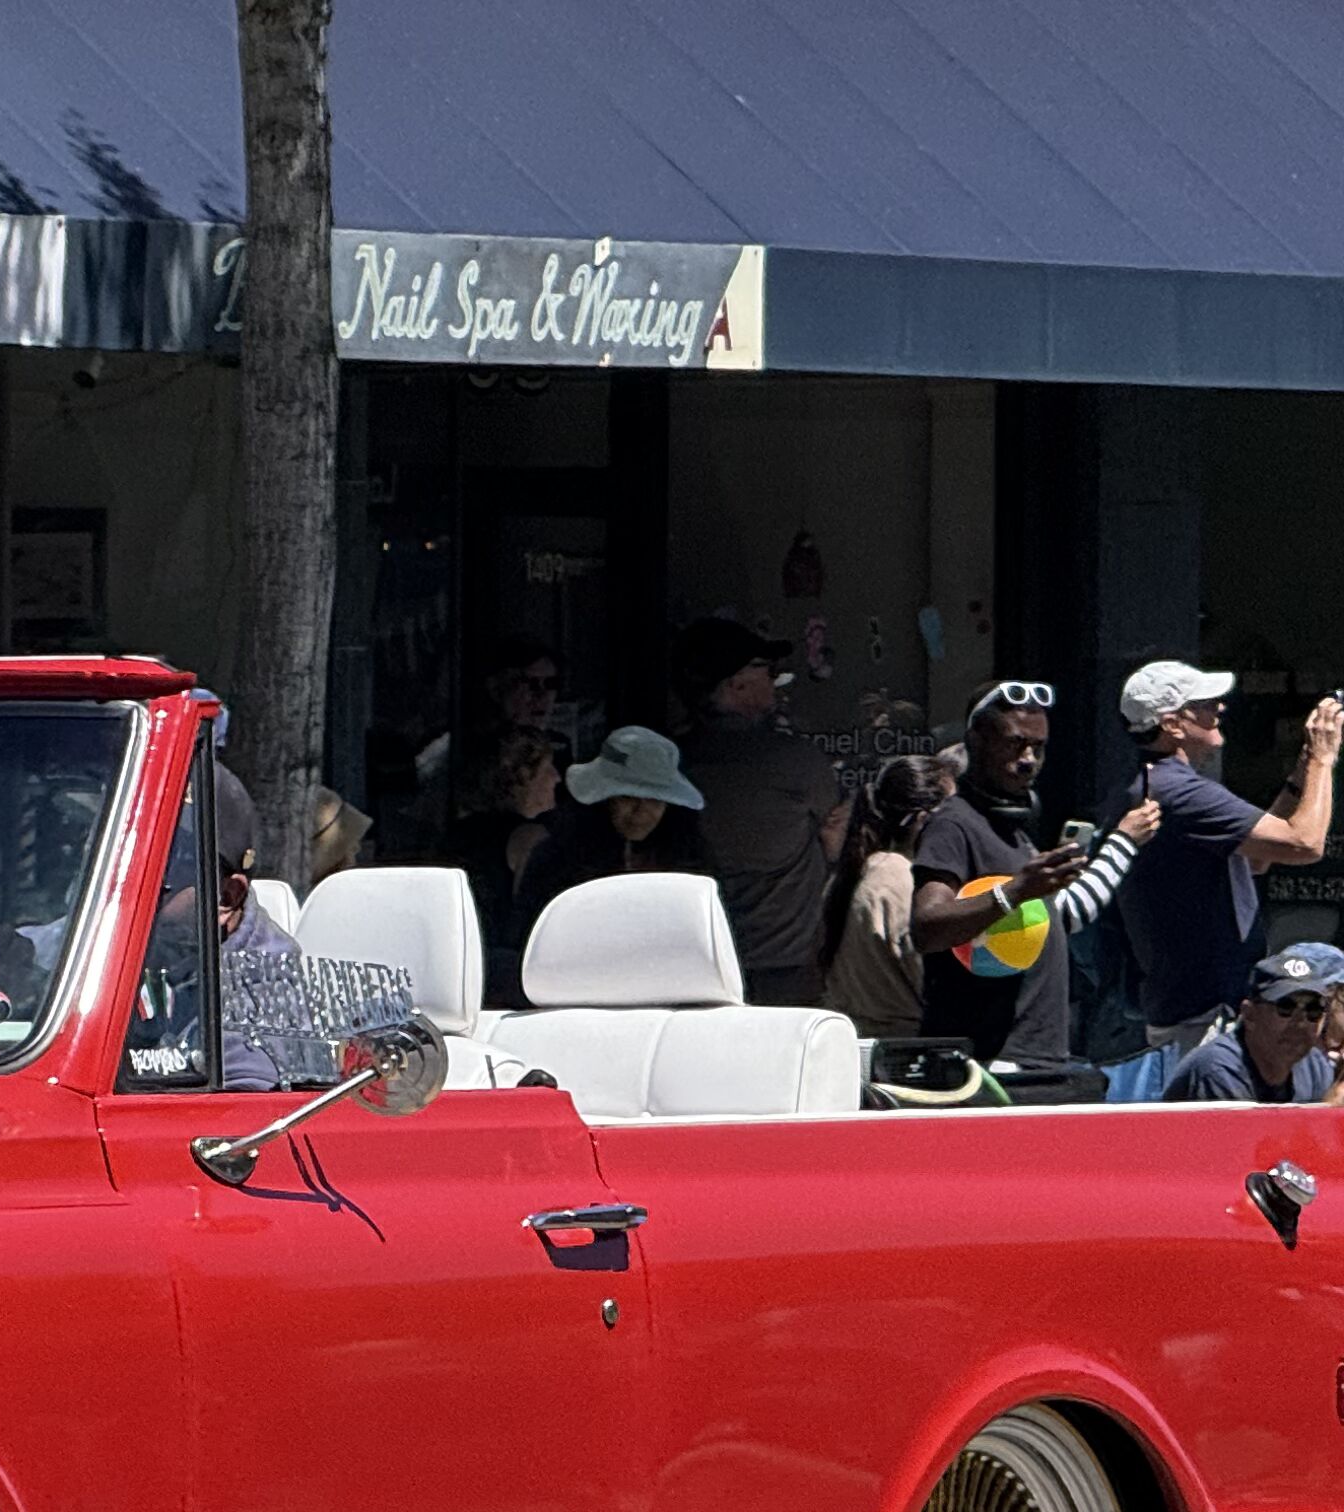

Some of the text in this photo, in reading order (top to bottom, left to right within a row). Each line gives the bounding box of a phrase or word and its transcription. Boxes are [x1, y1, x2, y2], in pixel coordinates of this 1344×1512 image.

[339, 243, 443, 341] Nail
[448, 259, 518, 358] Spa
[531, 253, 566, 343] &
[569, 261, 704, 366] Waxing
[873, 727, 935, 754] Chin
